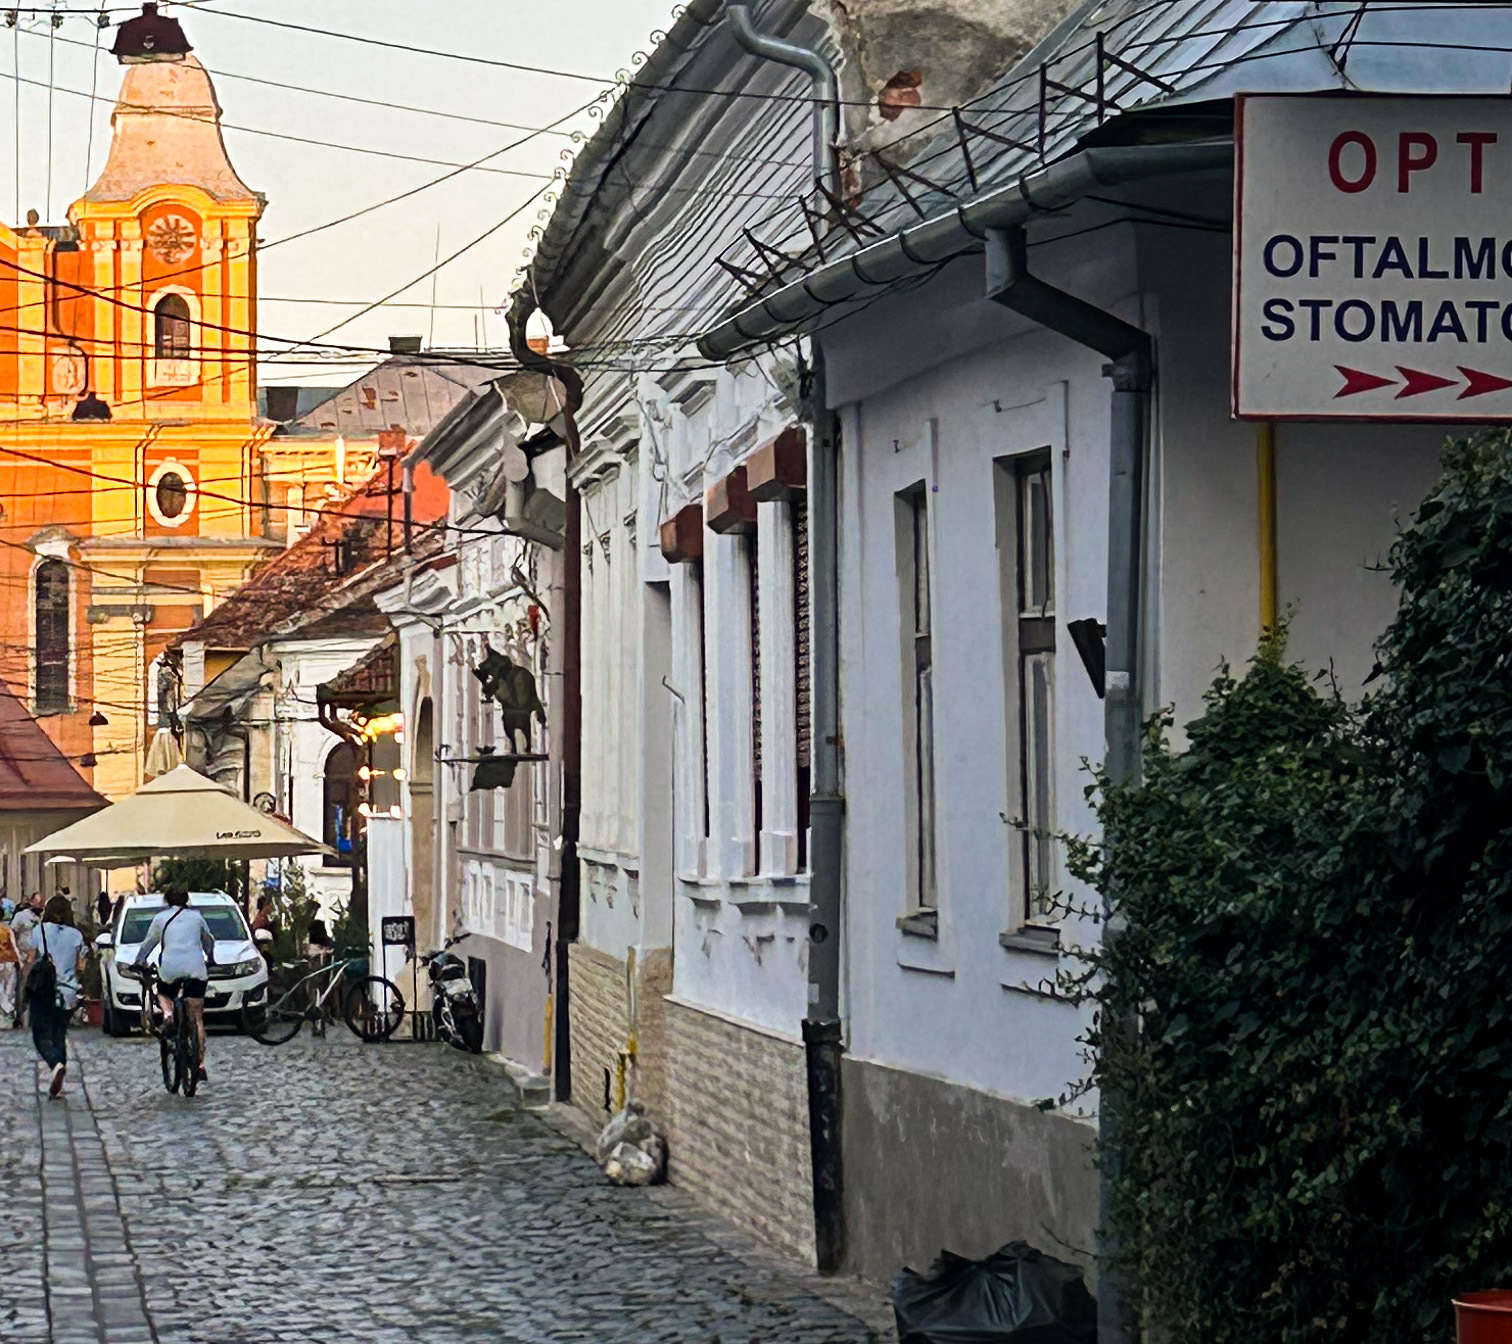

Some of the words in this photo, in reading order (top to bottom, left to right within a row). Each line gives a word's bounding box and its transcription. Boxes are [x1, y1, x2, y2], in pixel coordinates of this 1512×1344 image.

[1328, 130, 1498, 194] OPT
[1263, 234, 1512, 280] OFTALM
[1261, 298, 1512, 343] STOMAT
